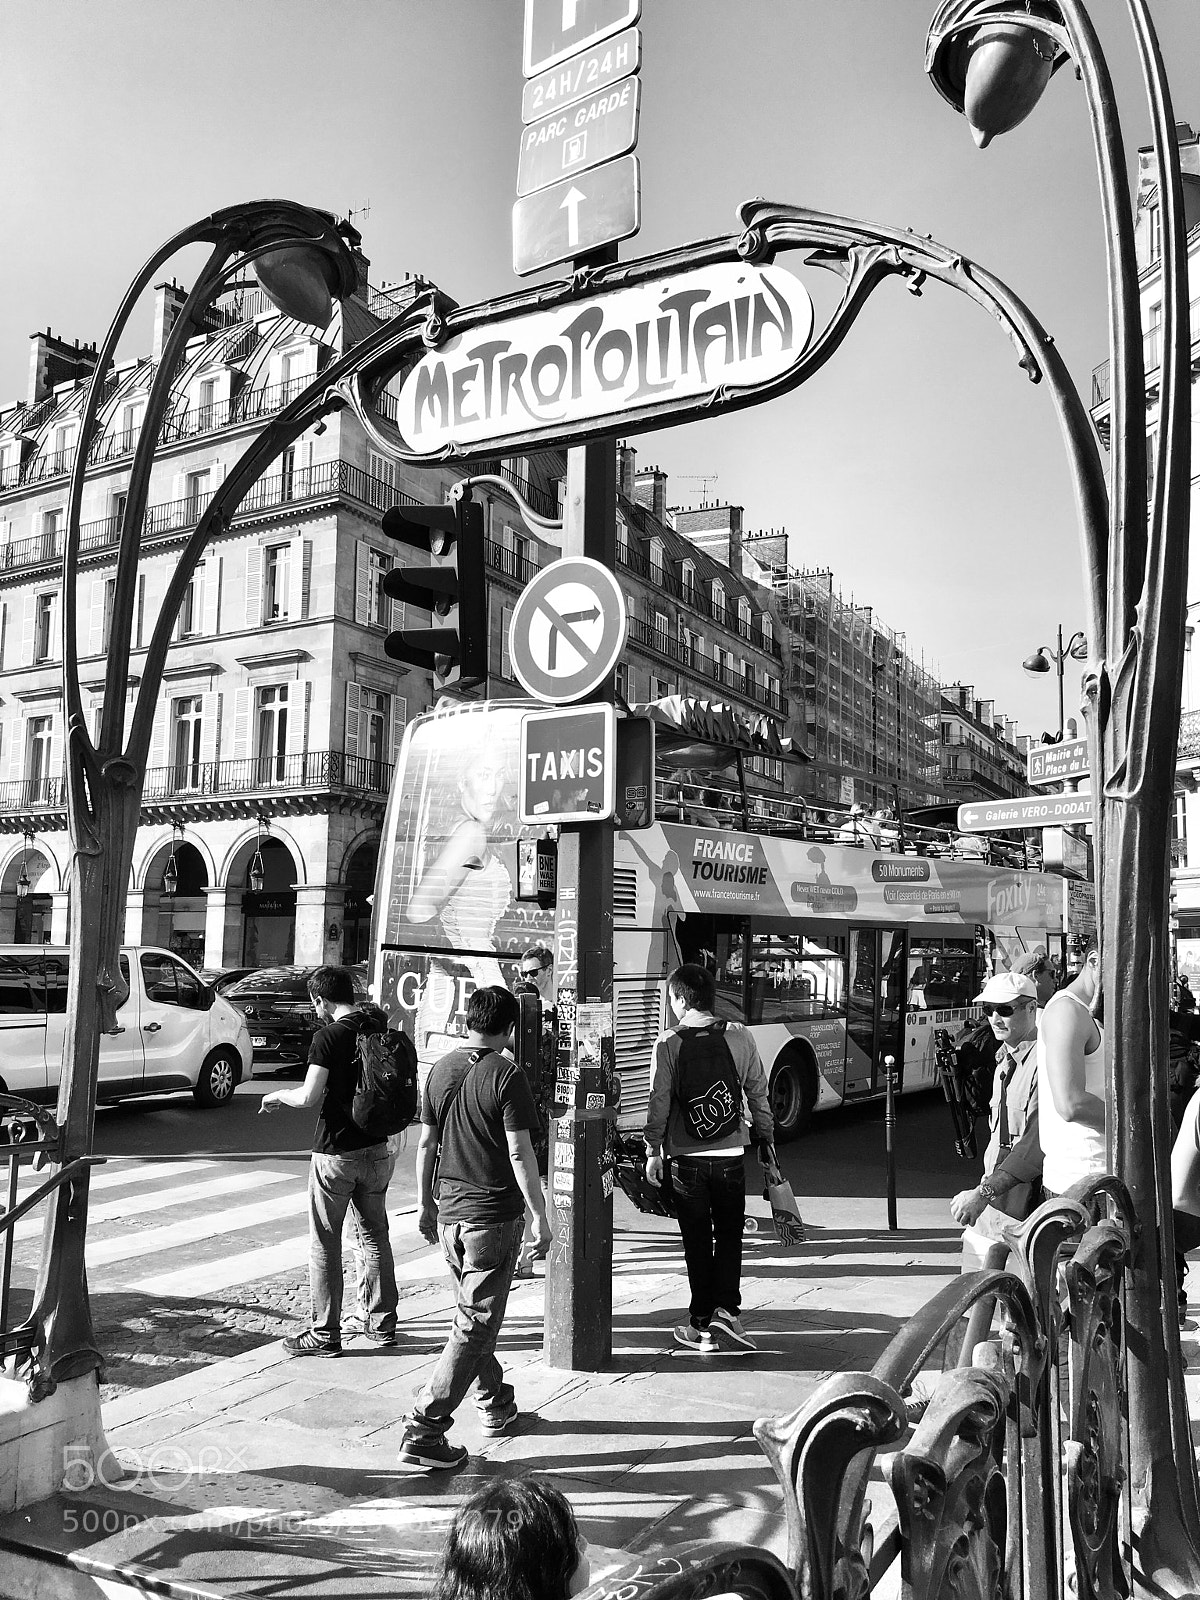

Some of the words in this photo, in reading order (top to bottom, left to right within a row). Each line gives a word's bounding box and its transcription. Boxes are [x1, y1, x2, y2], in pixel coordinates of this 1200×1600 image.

[532, 43, 628, 109] 24H/24H
[526, 118, 567, 151] PARC
[574, 83, 631, 127] GARDÉ
[1045, 748, 1071, 763] Mairie
[1073, 745, 1084, 757] du
[527, 747, 603, 782] TAXIS
[1045, 762, 1067, 776] Place
[1070, 760, 1080, 771] du
[985, 809, 1018, 821] Galerie
[1022, 801, 1092, 818] VERO-DODAT
[692, 838, 754, 863] FRANCE
[539, 856, 554, 871] BNE
[691, 860, 768, 885] TOURISME
[879, 864, 888, 877] 50
[889, 864, 924, 877] Monuments
[539, 871, 554, 880] WAS
[539, 880, 554, 888] HERE
[693, 888, 761, 901] www.francetourisme.fr
